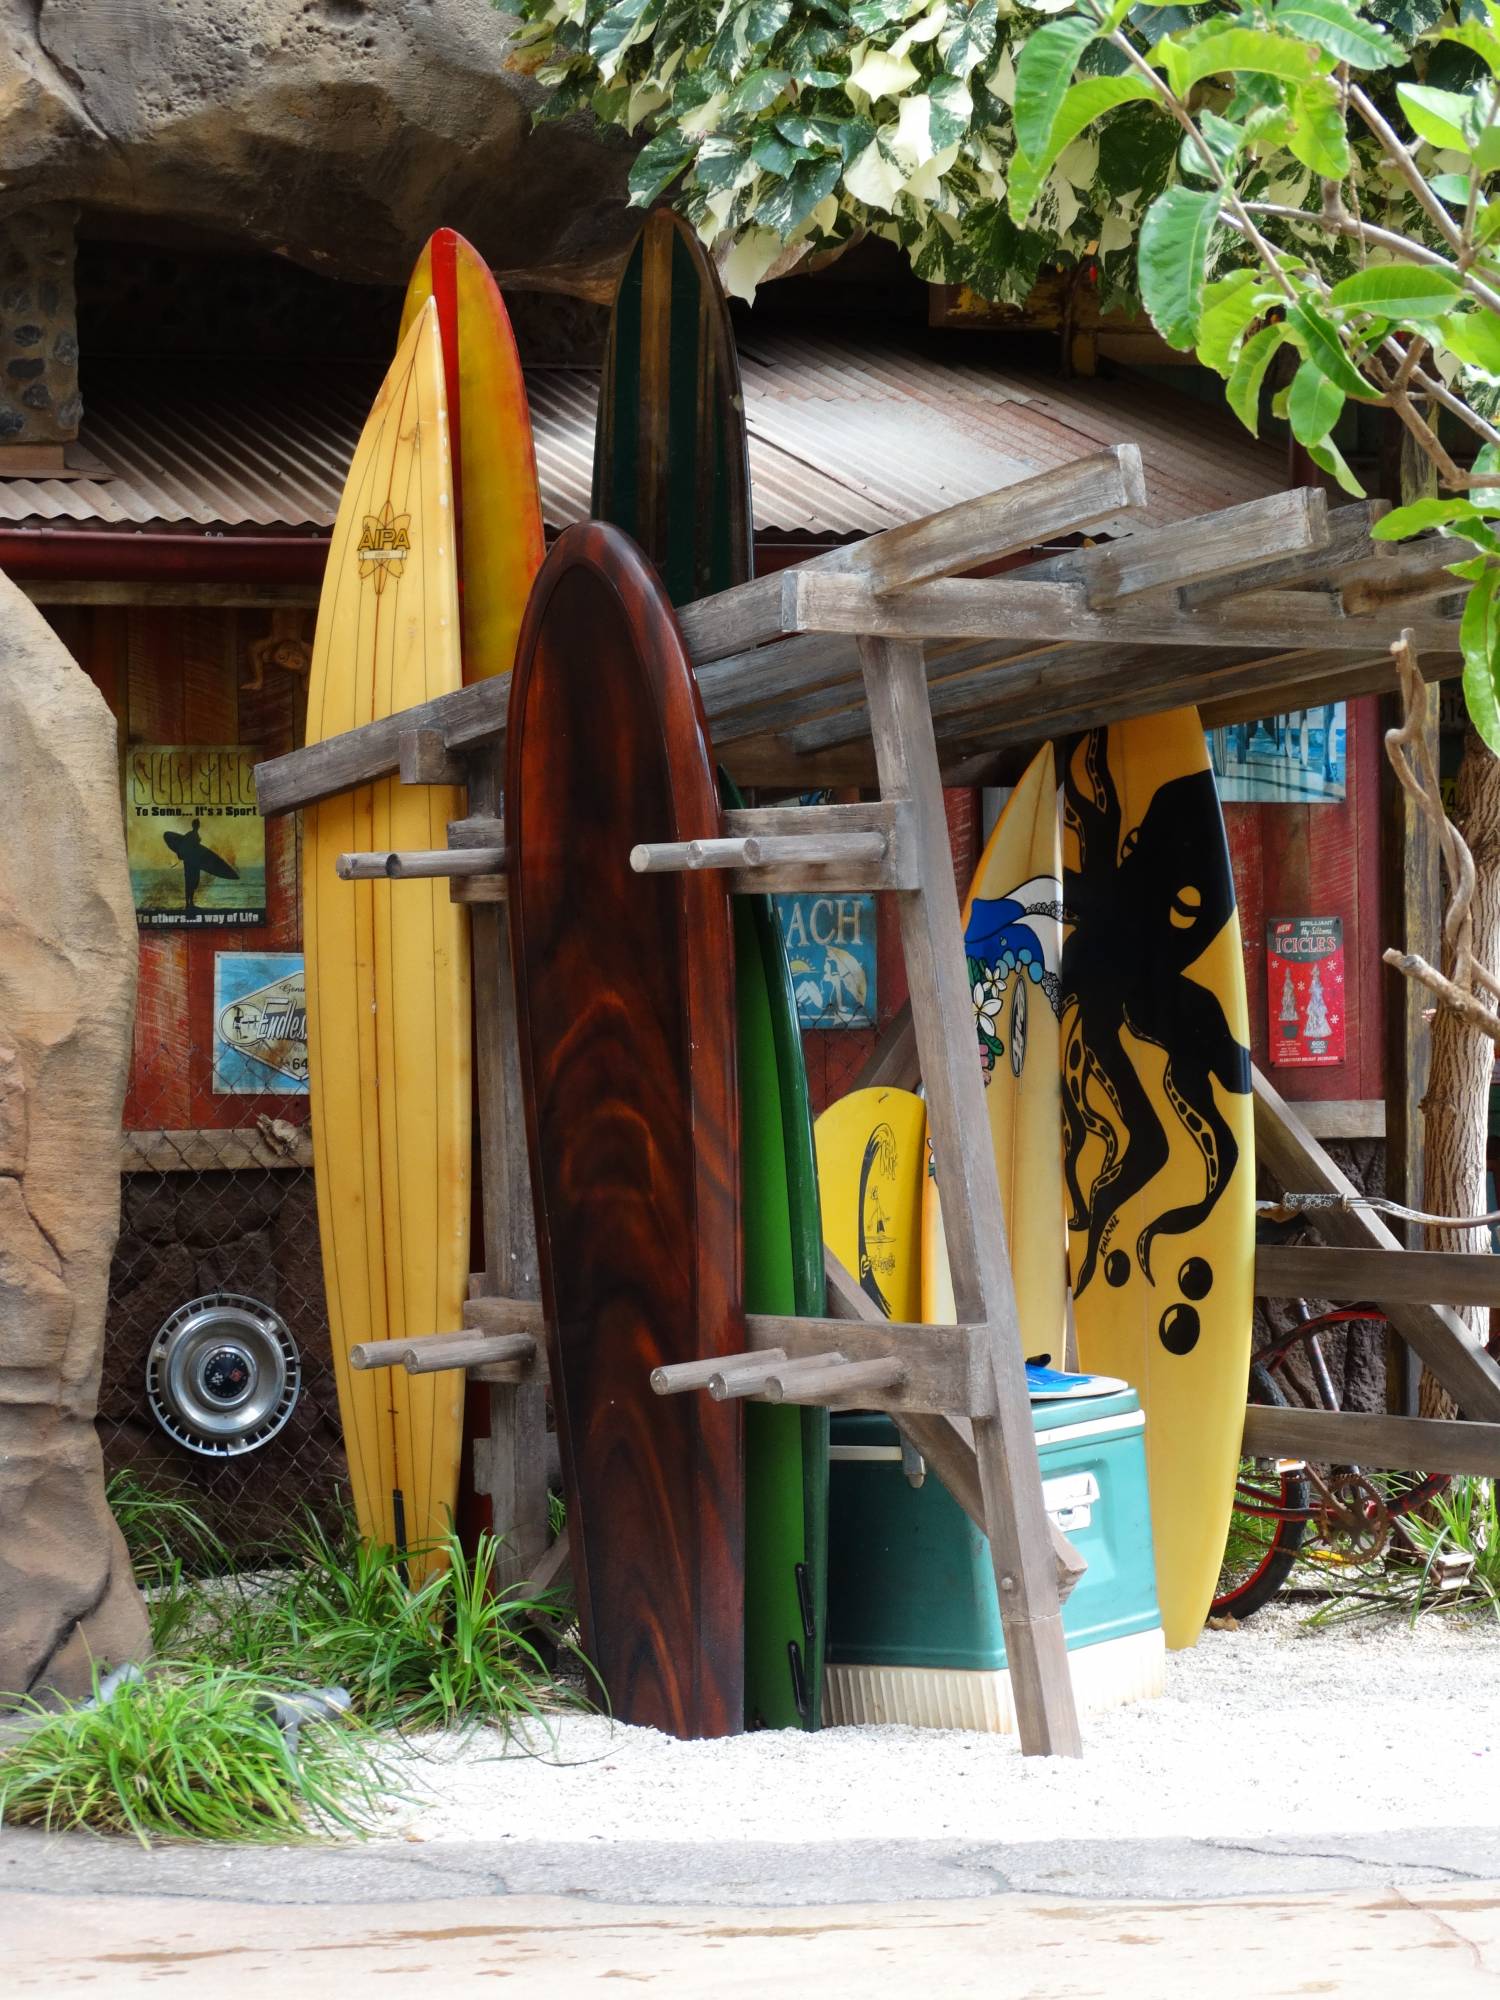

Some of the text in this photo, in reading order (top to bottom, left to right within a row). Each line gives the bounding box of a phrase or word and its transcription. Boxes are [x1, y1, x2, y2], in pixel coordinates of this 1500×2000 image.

[357, 528, 411, 551] AIPA
[133, 751, 257, 805] SURFING
[136, 806, 149, 817] To
[195, 806, 214, 817] It's
[216, 808, 223, 816] a
[225, 805, 257, 818] Sport
[204, 914, 225, 925] way
[227, 912, 238, 923] of
[239, 912, 259, 923] Life
[779, 899, 865, 948] ACH
[1275, 936, 1337, 954] ICICLES
[1099, 1215, 1120, 1258] KALANI
